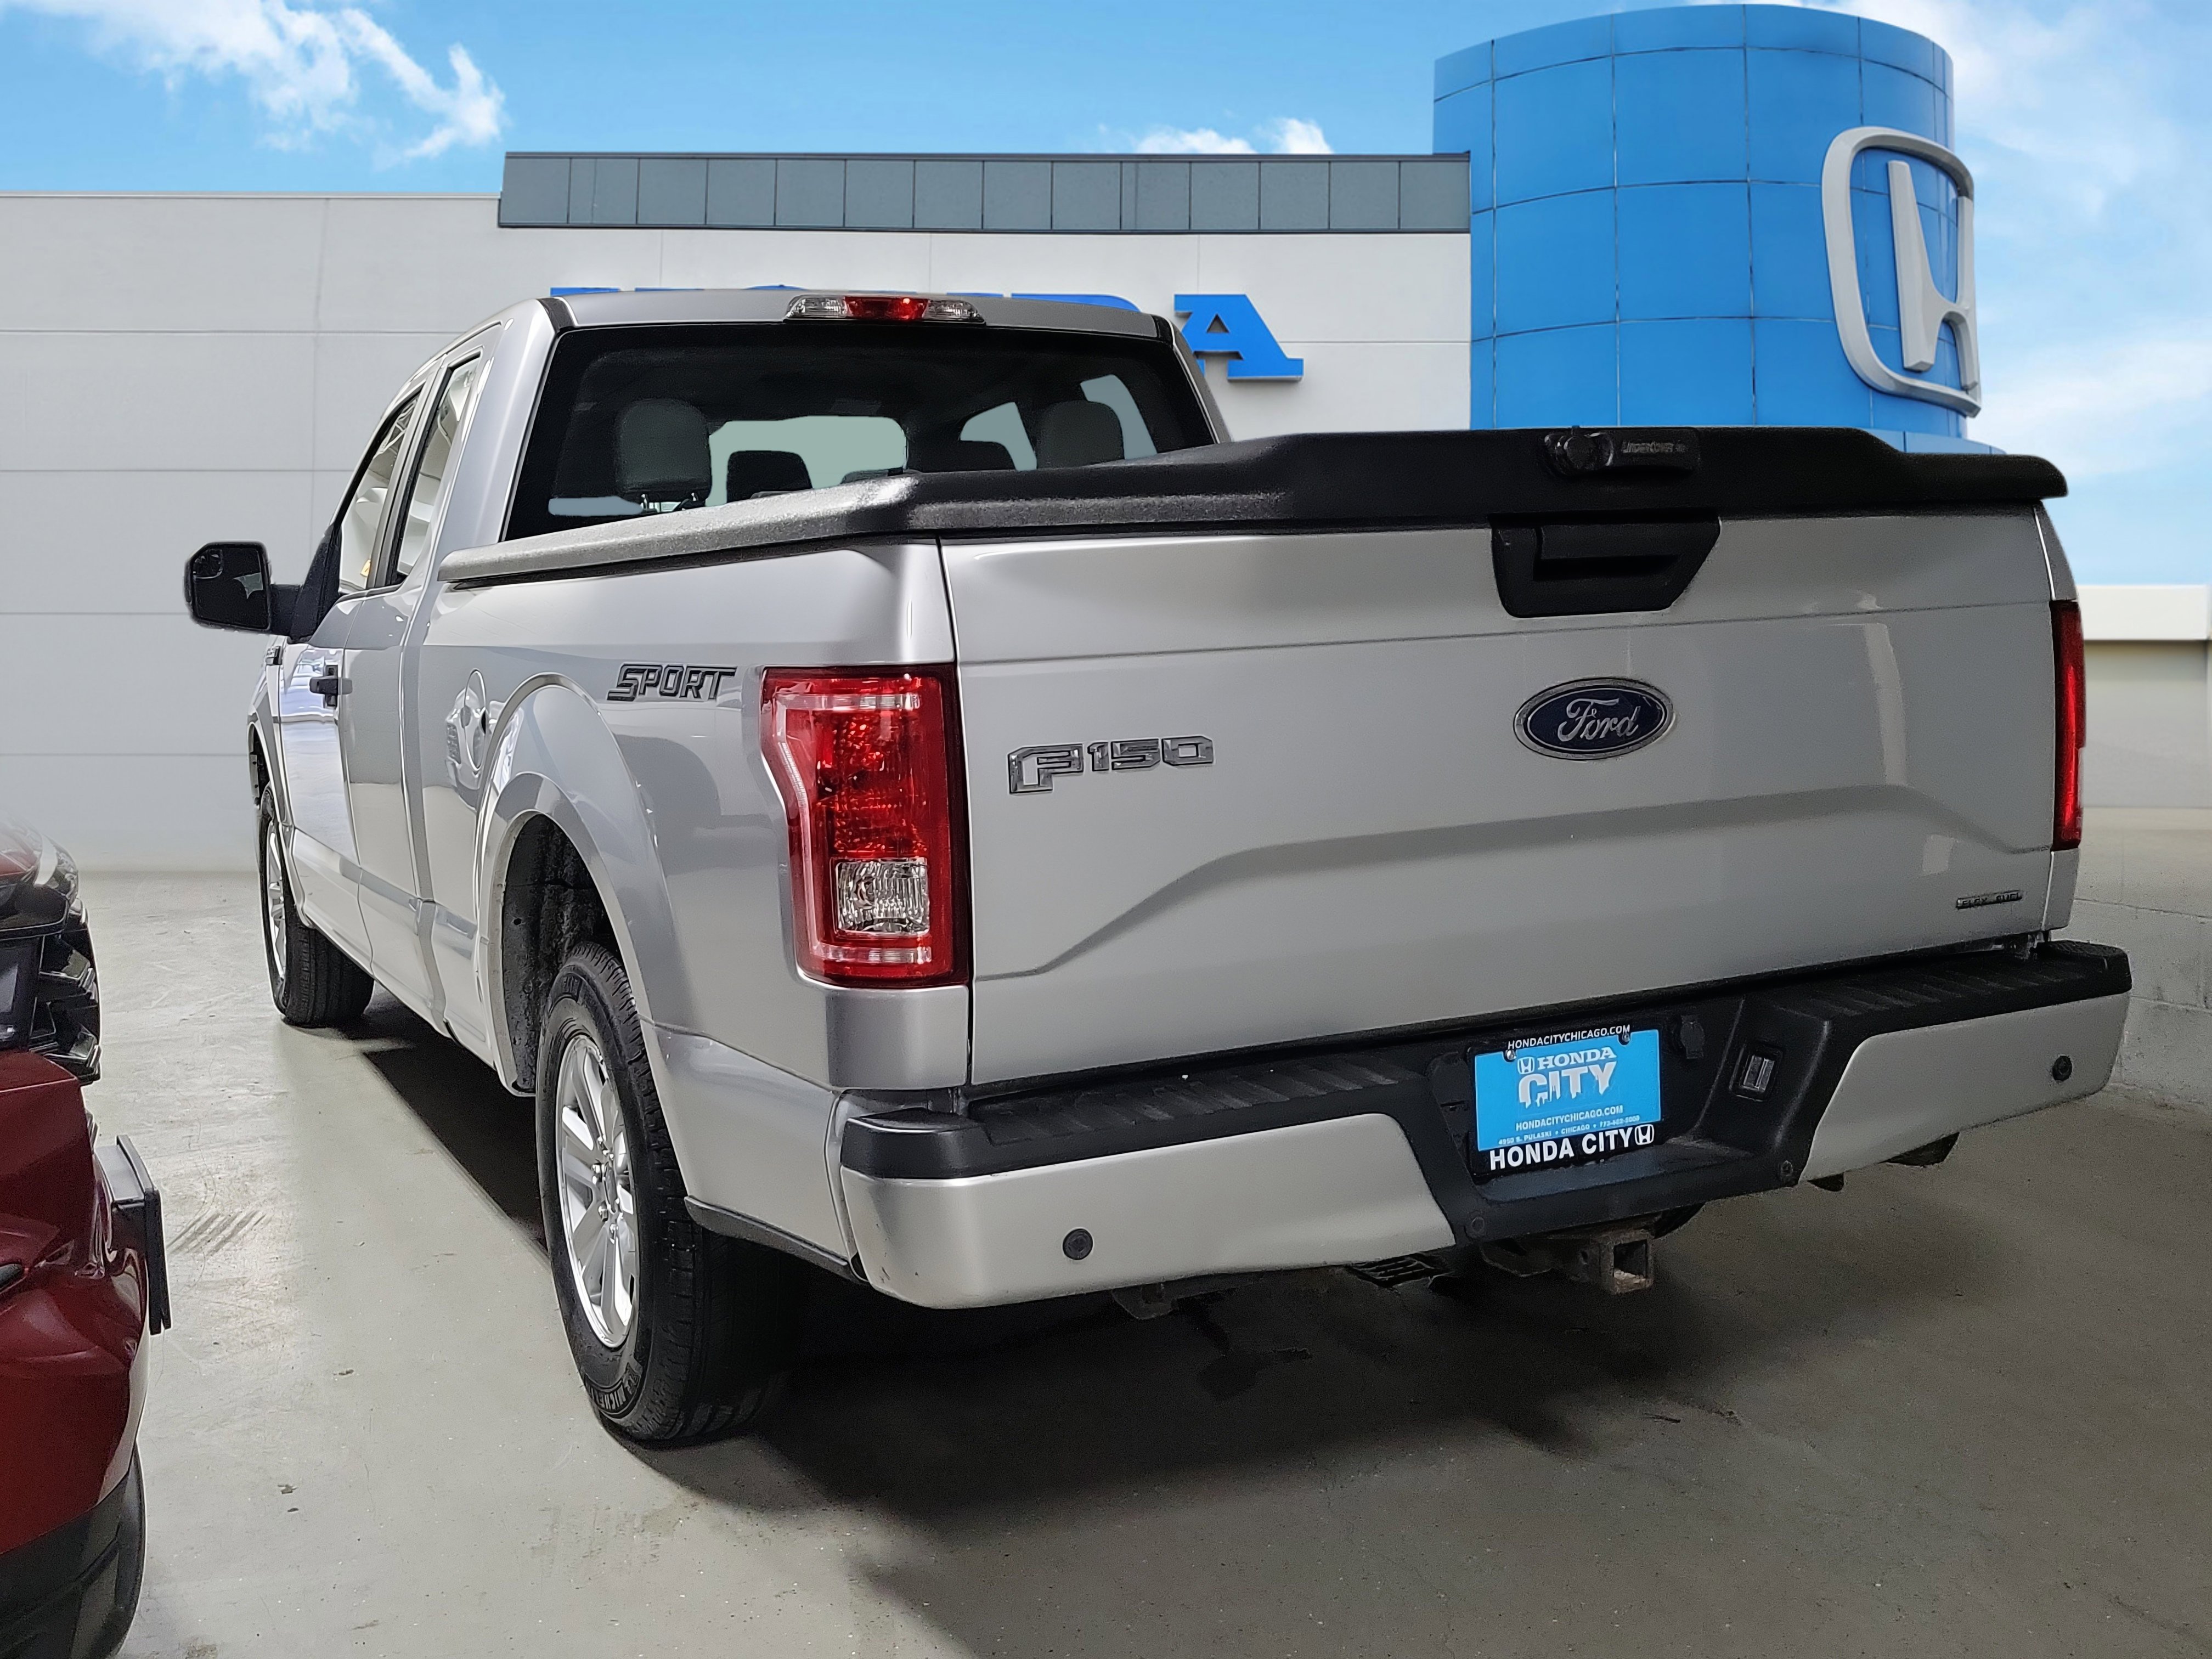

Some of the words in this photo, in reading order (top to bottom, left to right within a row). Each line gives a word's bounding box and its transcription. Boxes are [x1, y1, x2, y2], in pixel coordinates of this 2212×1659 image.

[607, 663, 737, 702] SPORT
[1558, 698, 1641, 742] Ford
[1508, 1024, 1630, 1049] HONDACITYCHICAGO.COM
[1537, 1046, 1617, 1070] HONDA
[1519, 1060, 1617, 1109] CITY
[1516, 1105, 1623, 1131] HONDACITYCHICAGO.COM
[1489, 1138, 1575, 1170] HONDA
[1582, 1127, 1633, 1154] CITY
[1523, 1131, 1552, 1141] PULASKI
